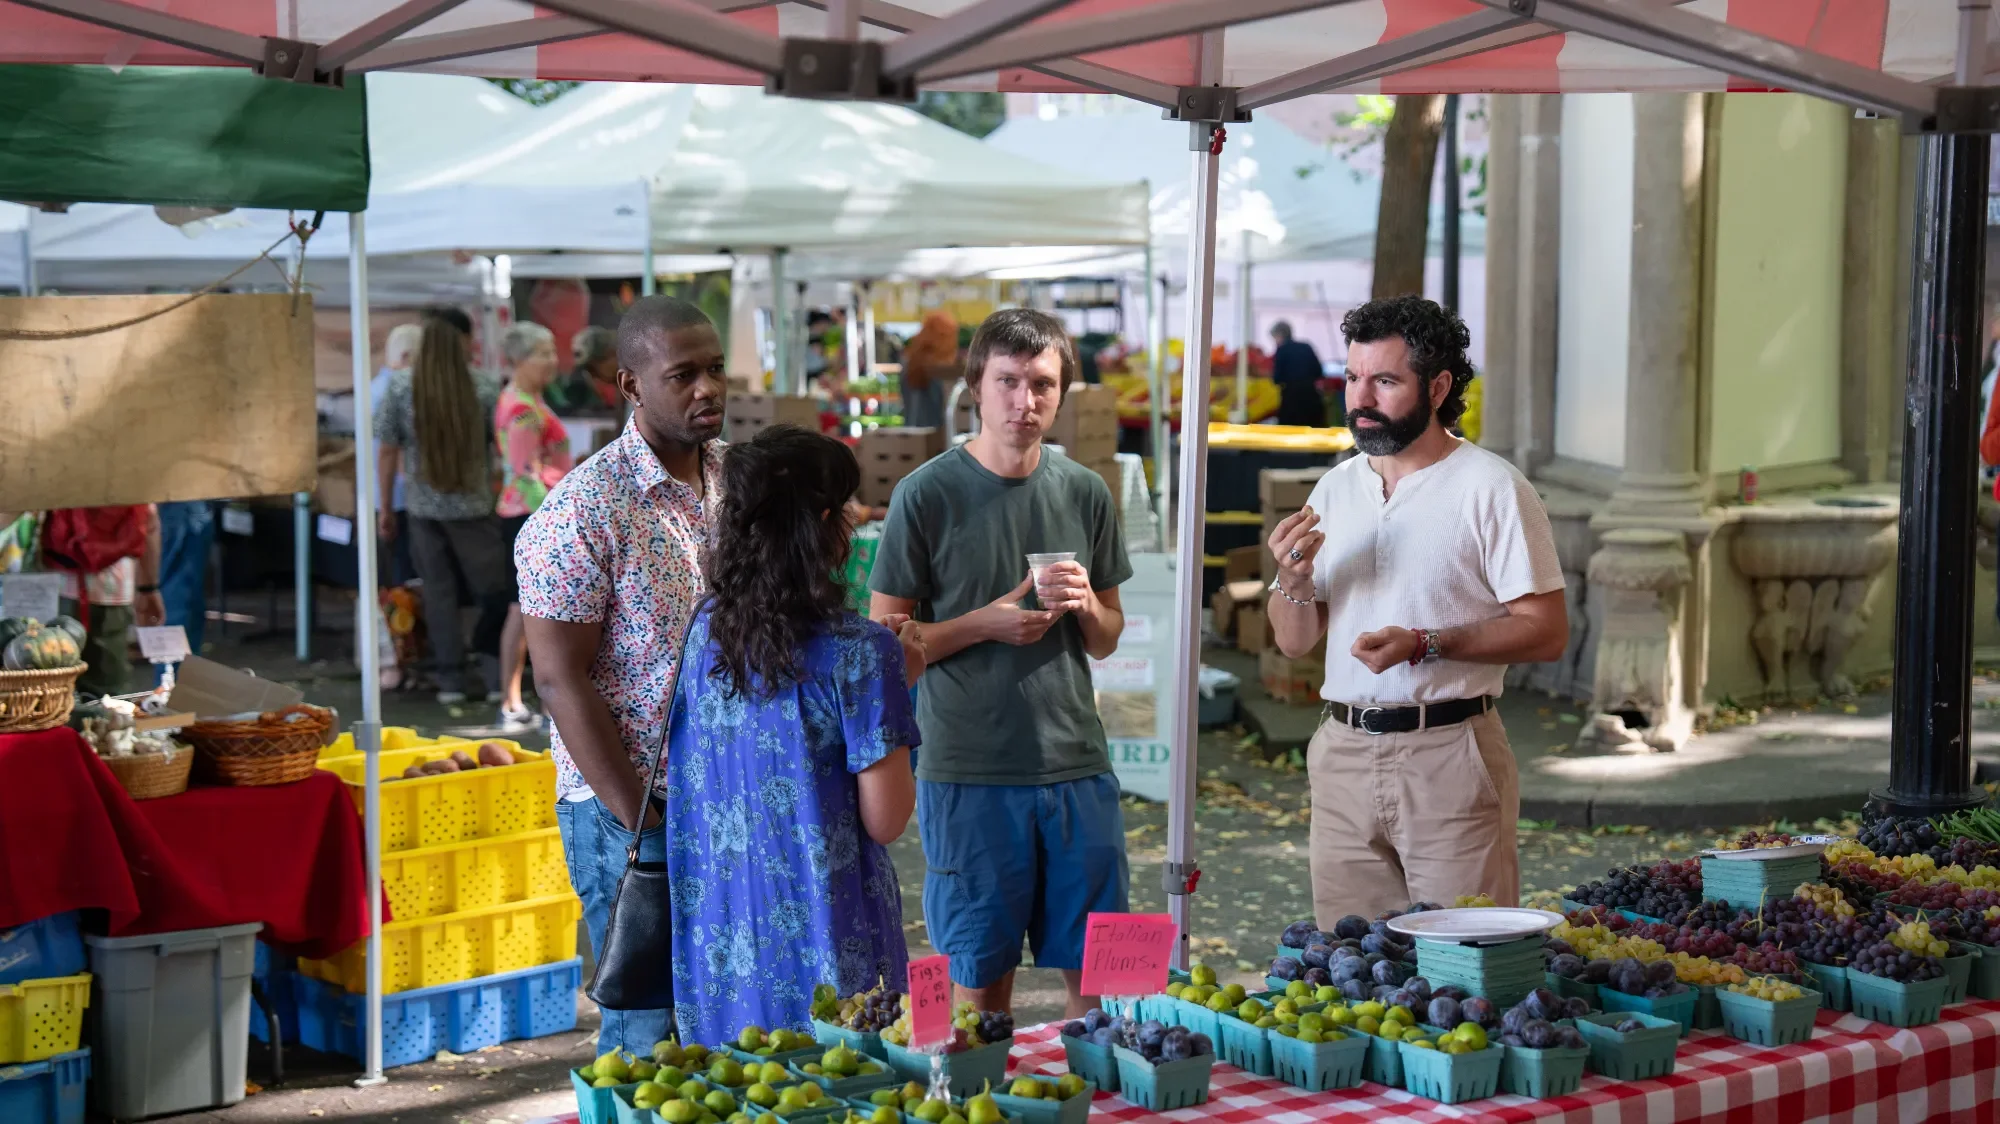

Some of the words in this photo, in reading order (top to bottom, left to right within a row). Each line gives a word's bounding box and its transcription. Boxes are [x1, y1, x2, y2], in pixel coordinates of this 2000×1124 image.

[1092, 922, 1163, 944] Italian
[909, 963, 943, 982] Figs
[919, 985, 929, 1008] 6
